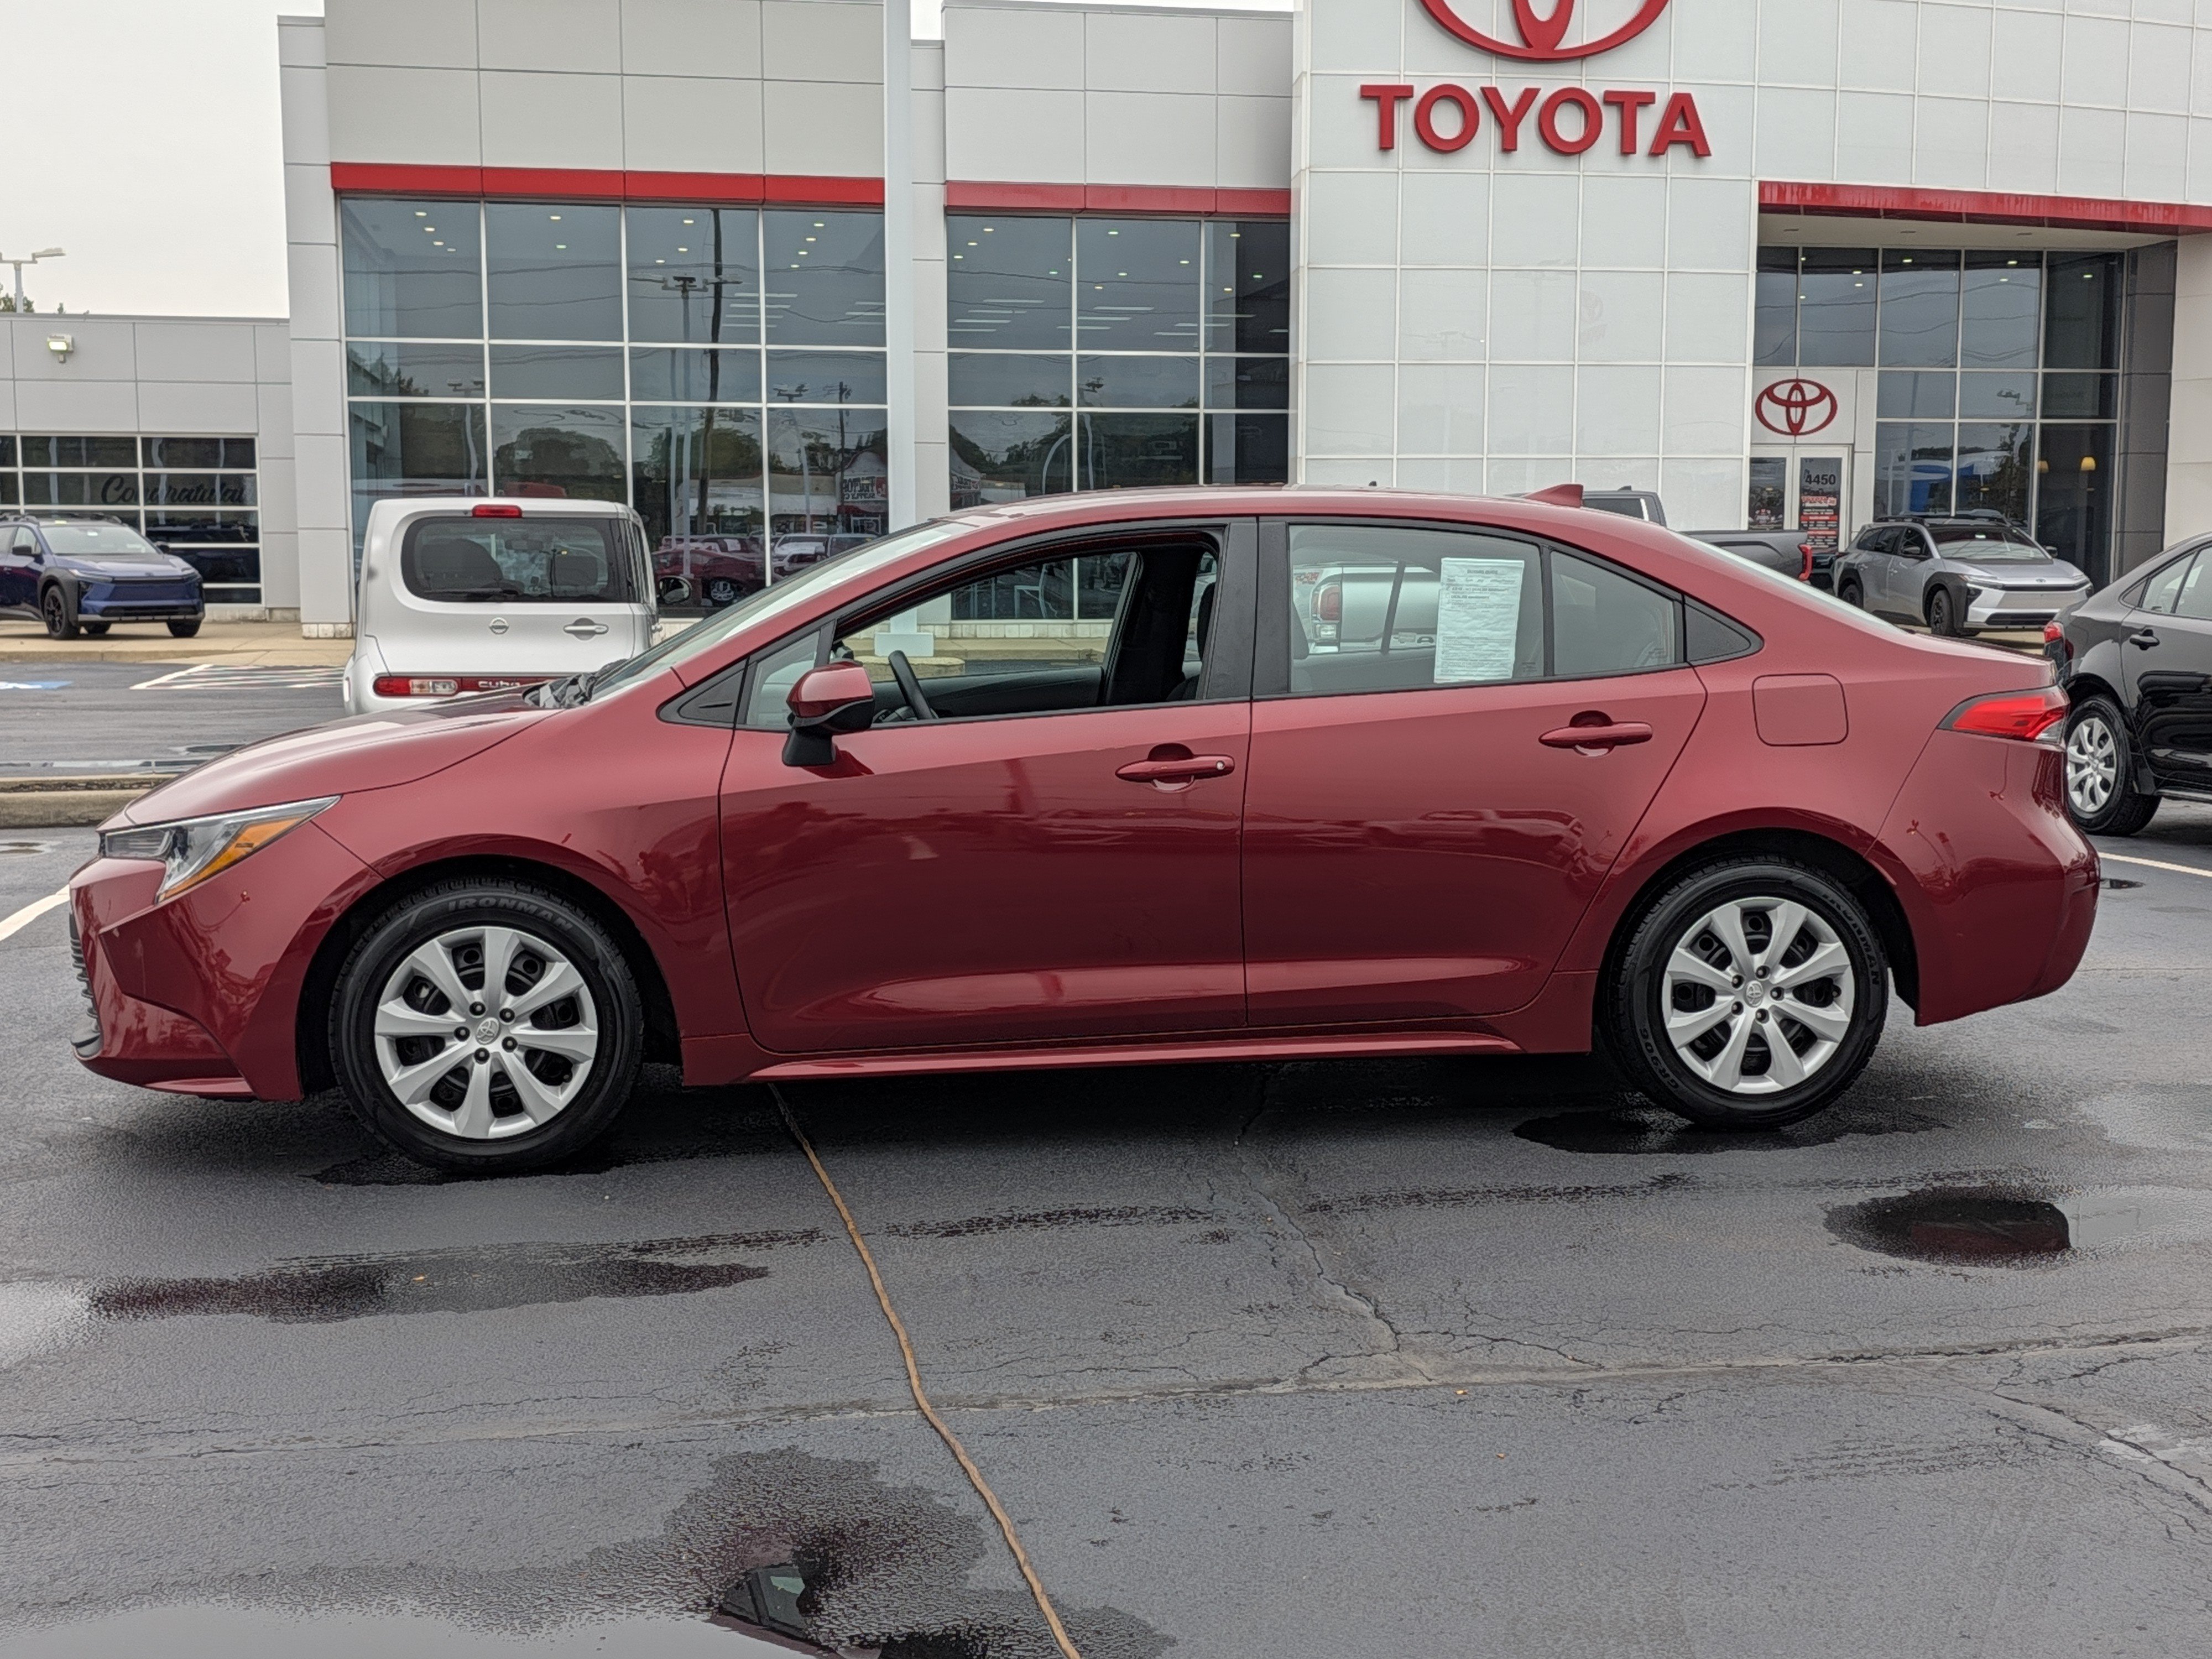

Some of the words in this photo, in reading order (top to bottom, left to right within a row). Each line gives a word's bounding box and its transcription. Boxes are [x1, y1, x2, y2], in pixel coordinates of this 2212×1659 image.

[1360, 83, 1712, 156] TOYOTA
[1805, 474, 1837, 485] 4450
[447, 896, 575, 931] IRONMAN
[1639, 1028, 1679, 1089] GR906
